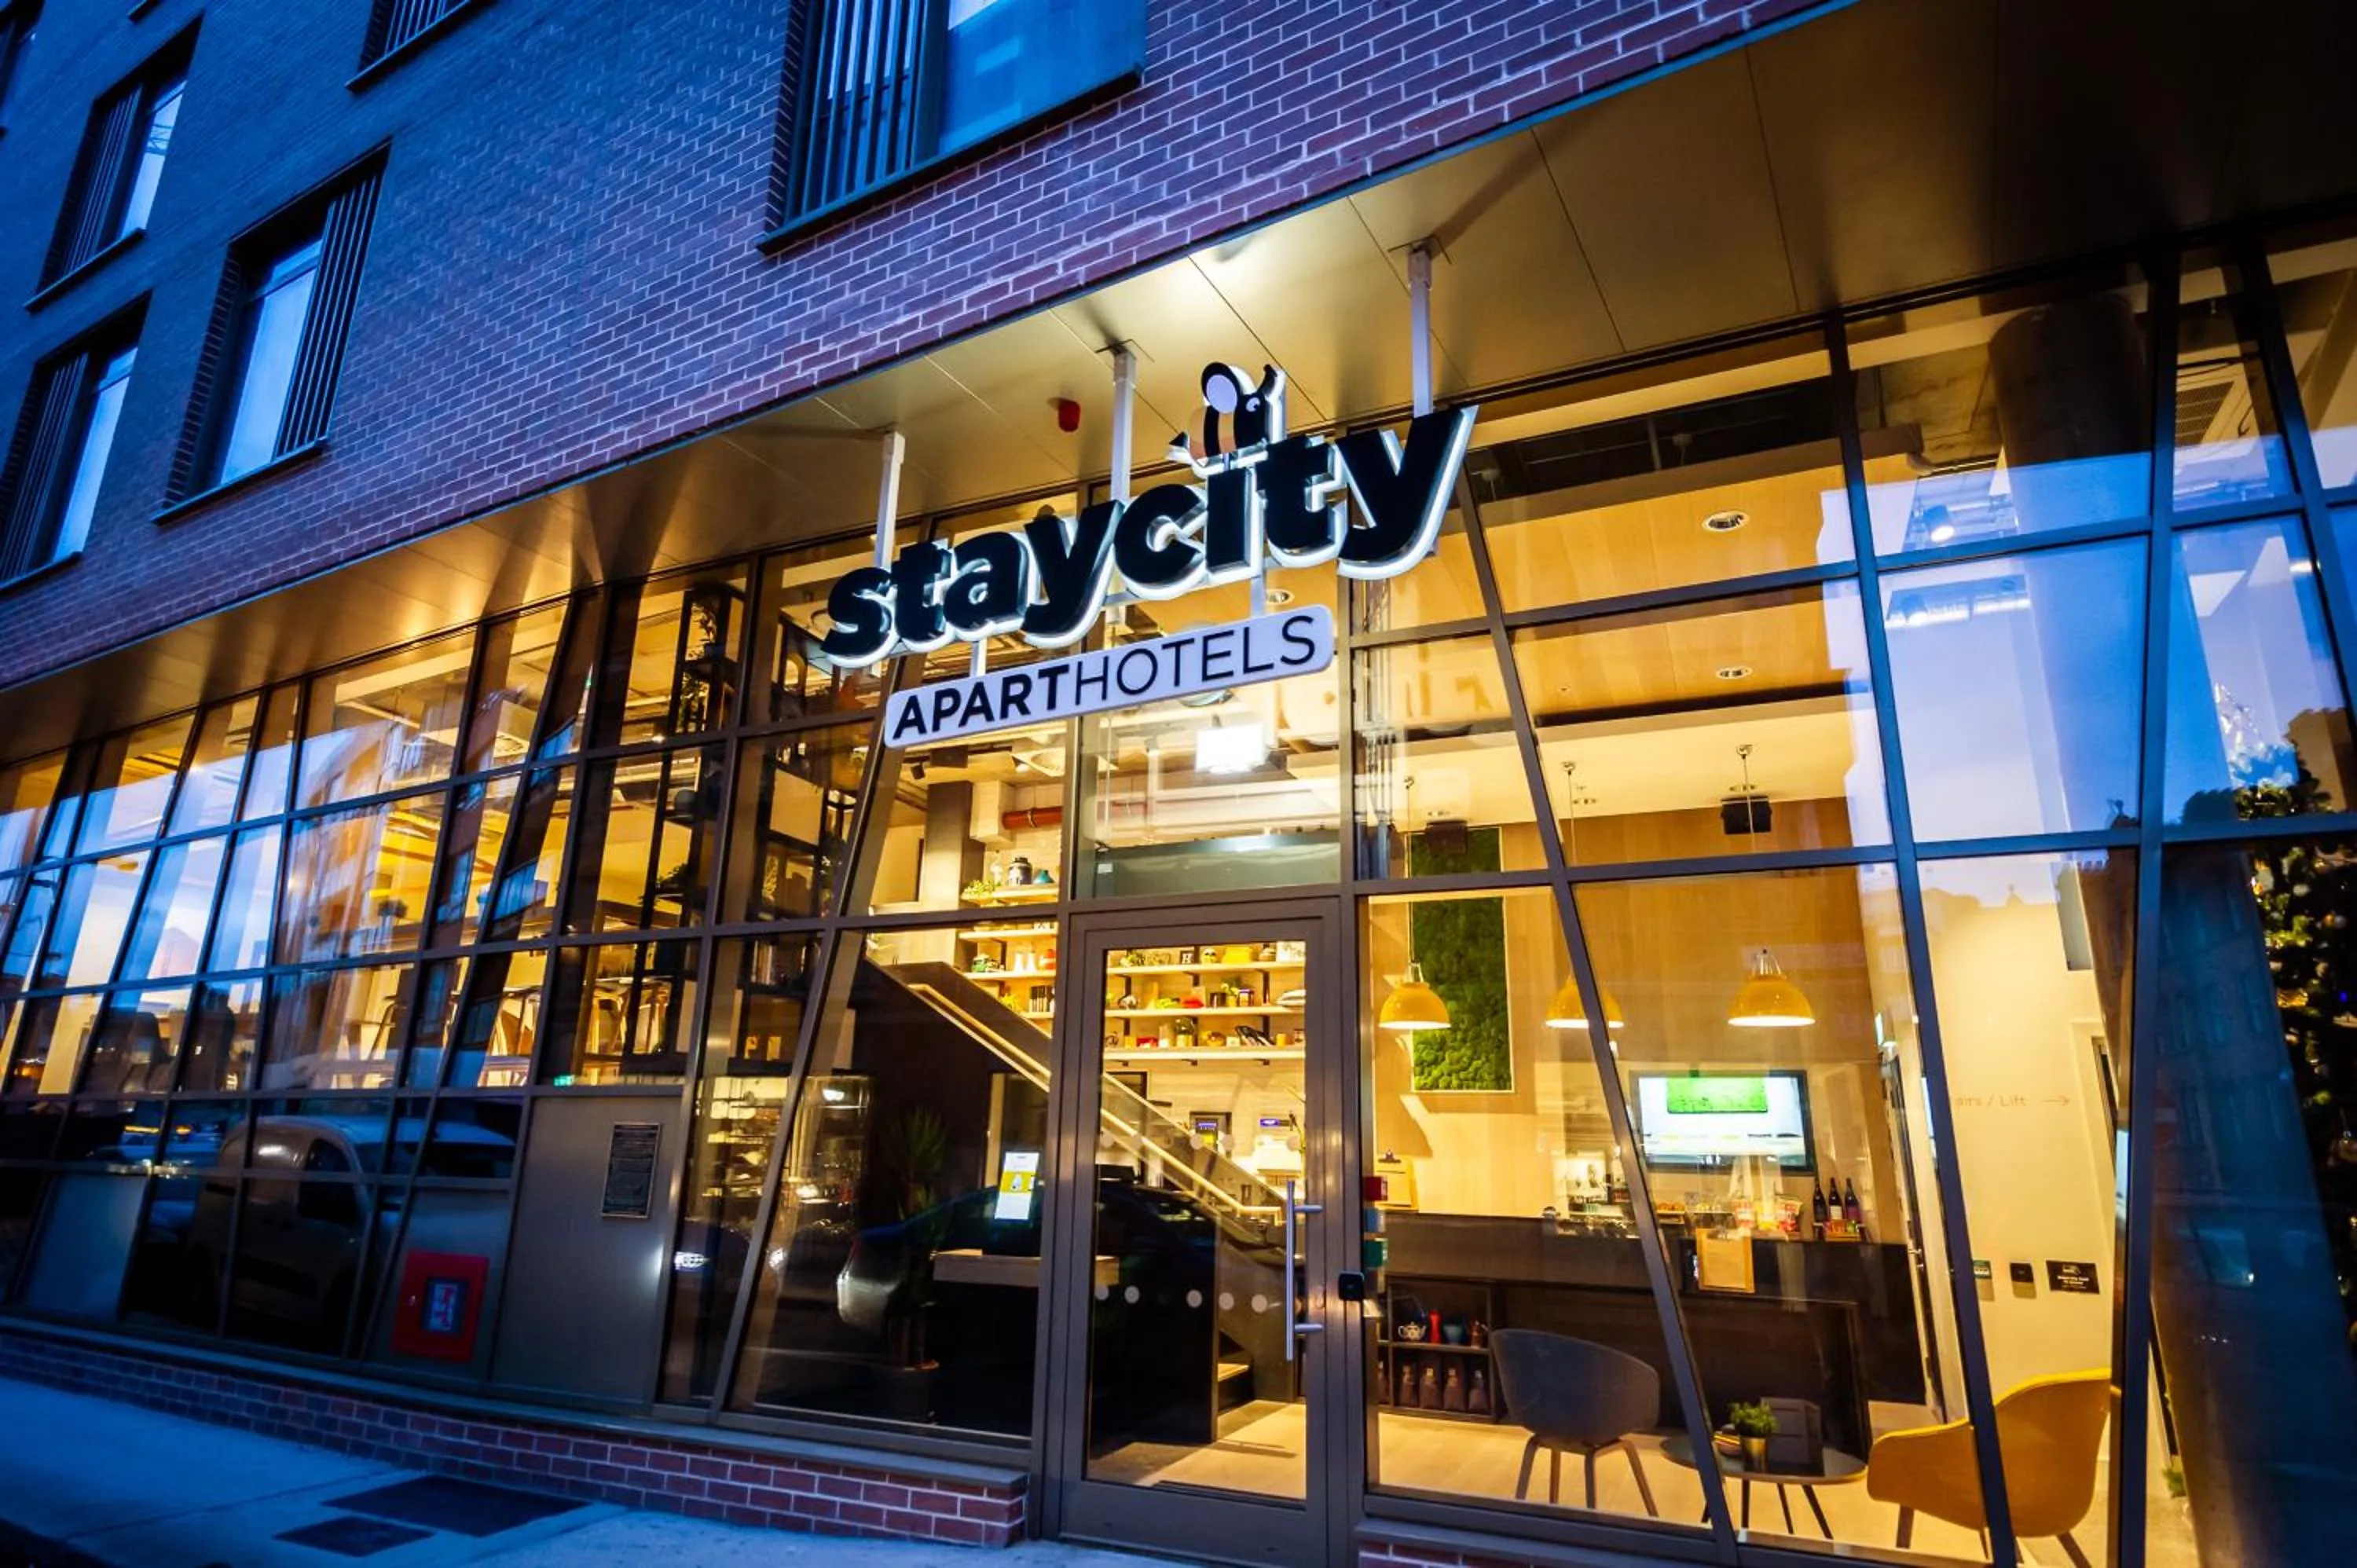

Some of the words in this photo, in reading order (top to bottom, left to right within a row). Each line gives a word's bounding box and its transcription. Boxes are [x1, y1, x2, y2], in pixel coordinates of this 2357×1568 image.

[820, 405, 1477, 668] staycity
[893, 614, 1317, 740] APARTHOTELS
[1997, 1094, 2027, 1107] Lift
